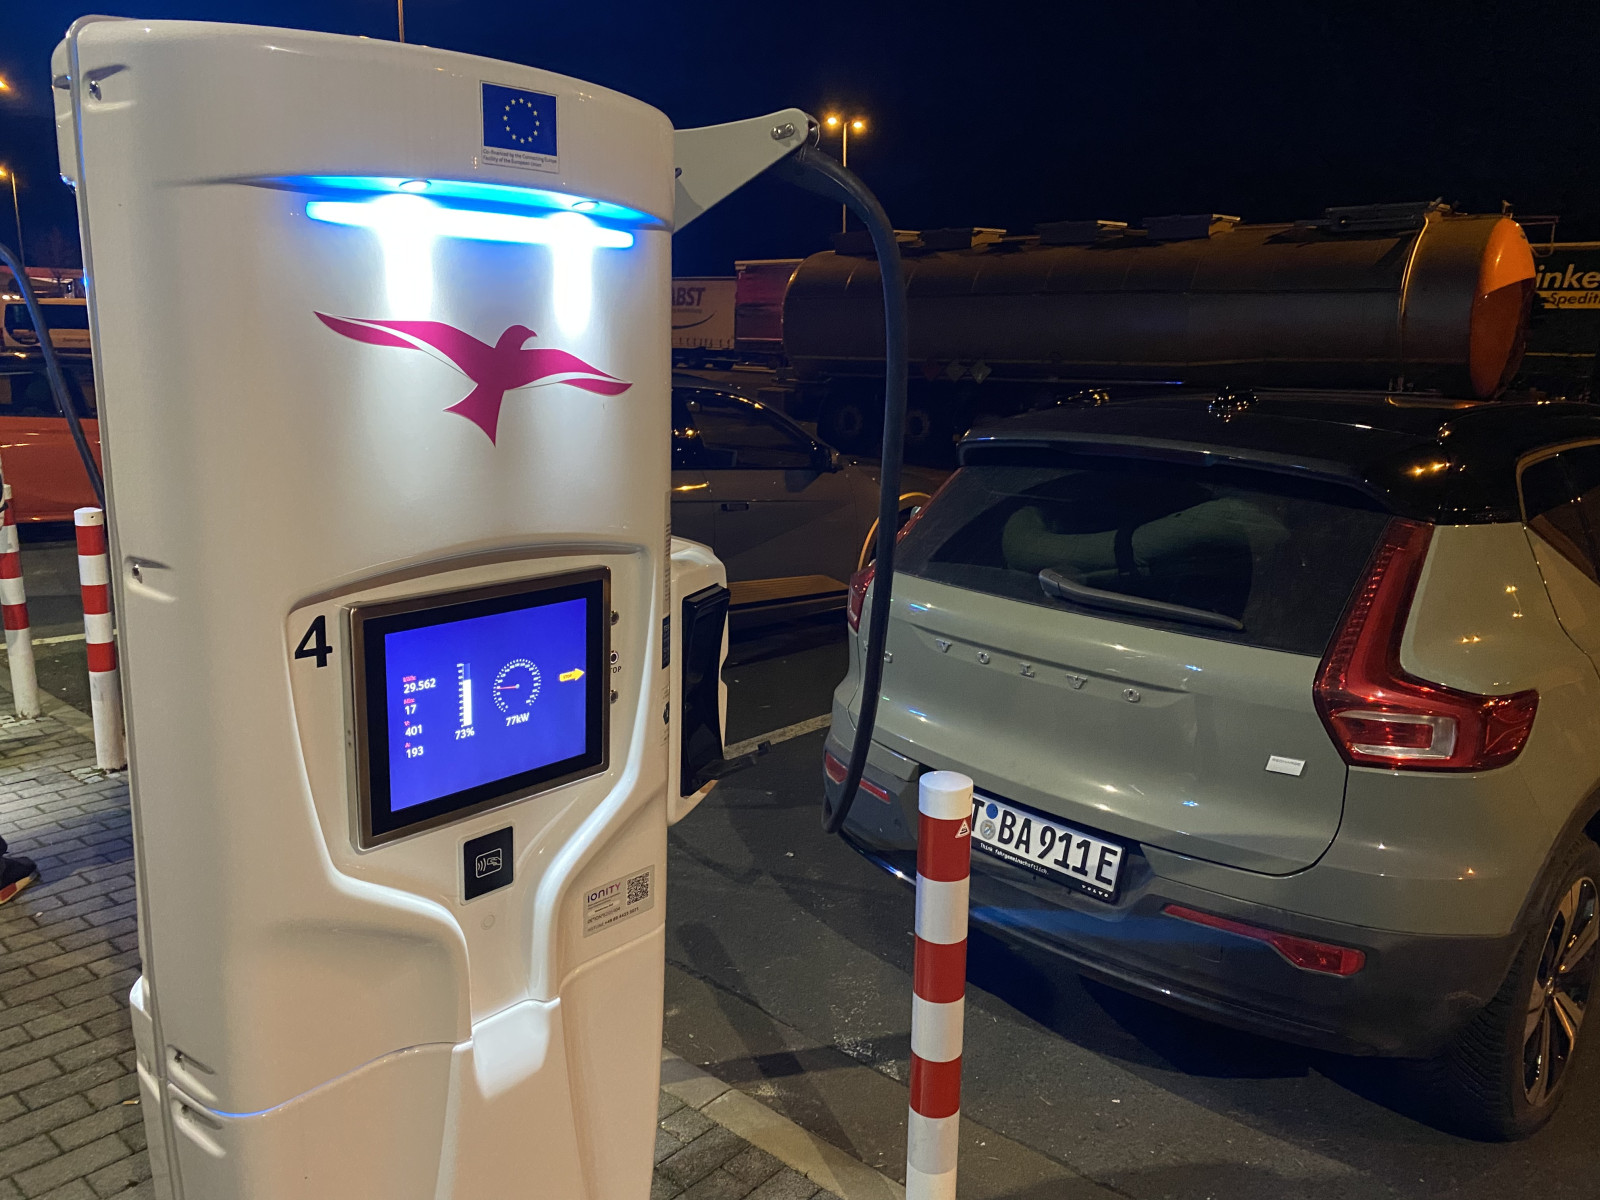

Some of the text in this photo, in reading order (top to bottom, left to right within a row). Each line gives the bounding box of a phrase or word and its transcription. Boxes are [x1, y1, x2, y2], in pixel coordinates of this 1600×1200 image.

[1550, 292, 1600, 307] Spedit
[295, 615, 333, 668] 4
[611, 665, 622, 674] OP
[935, 638, 1141, 703] VOLVO
[403, 677, 436, 694] 29.562
[404, 703, 417, 715] 17
[505, 711, 530, 727] 77kW
[405, 724, 422, 737] 401
[454, 726, 475, 740] 73%
[406, 745, 424, 759] 193
[997, 809, 1032, 854] BA
[1037, 825, 1118, 886] 911E
[1081, 884, 1109, 898] VOLVO
